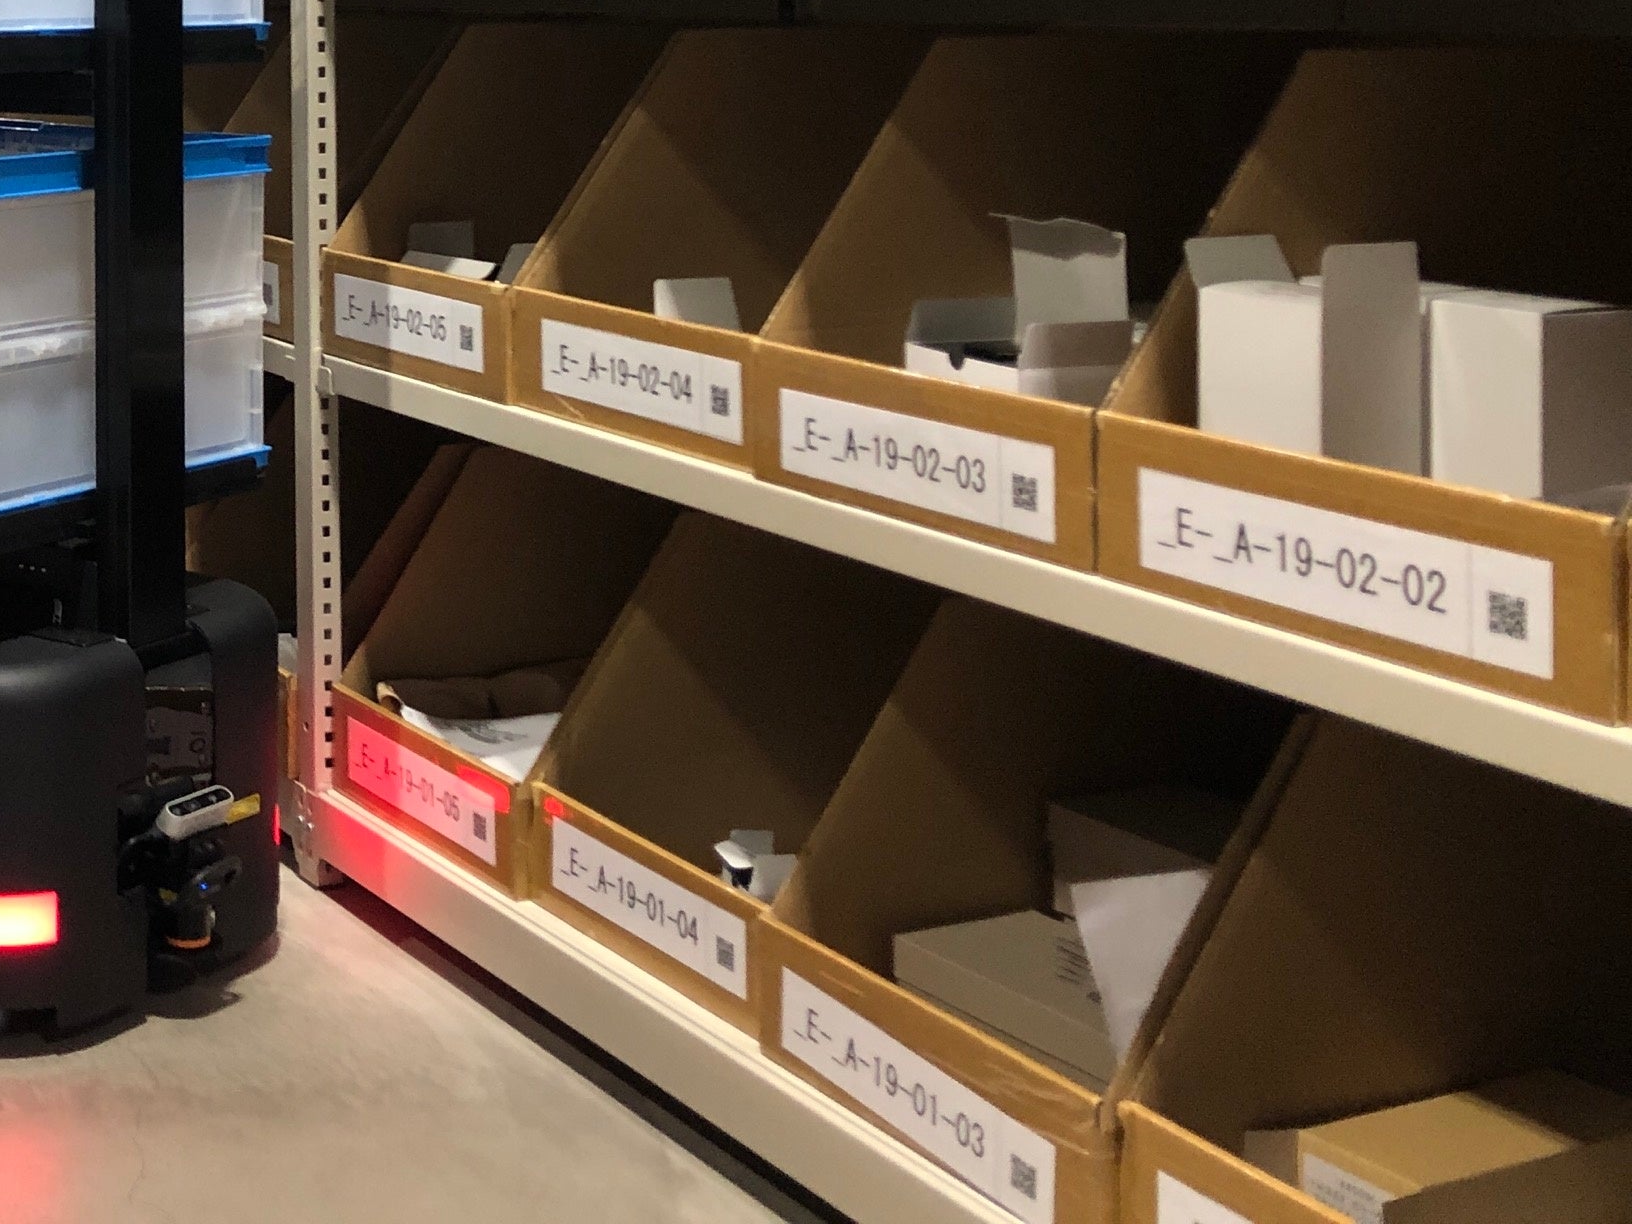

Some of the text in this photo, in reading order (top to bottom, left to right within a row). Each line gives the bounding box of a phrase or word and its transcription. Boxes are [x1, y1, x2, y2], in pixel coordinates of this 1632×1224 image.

[341, 289, 448, 343] _E-_A-19-02-05
[550, 344, 694, 403] _E-_A-19-02-04
[791, 416, 988, 495] _E-_A-19-02-03
[1158, 506, 1449, 616] _E-_A-19-02-02
[353, 742, 462, 823] _E-_A-19-01-05
[559, 848, 699, 947] _E-_A-19-01-04
[793, 1008, 987, 1158] _E-_A-19-01-03
